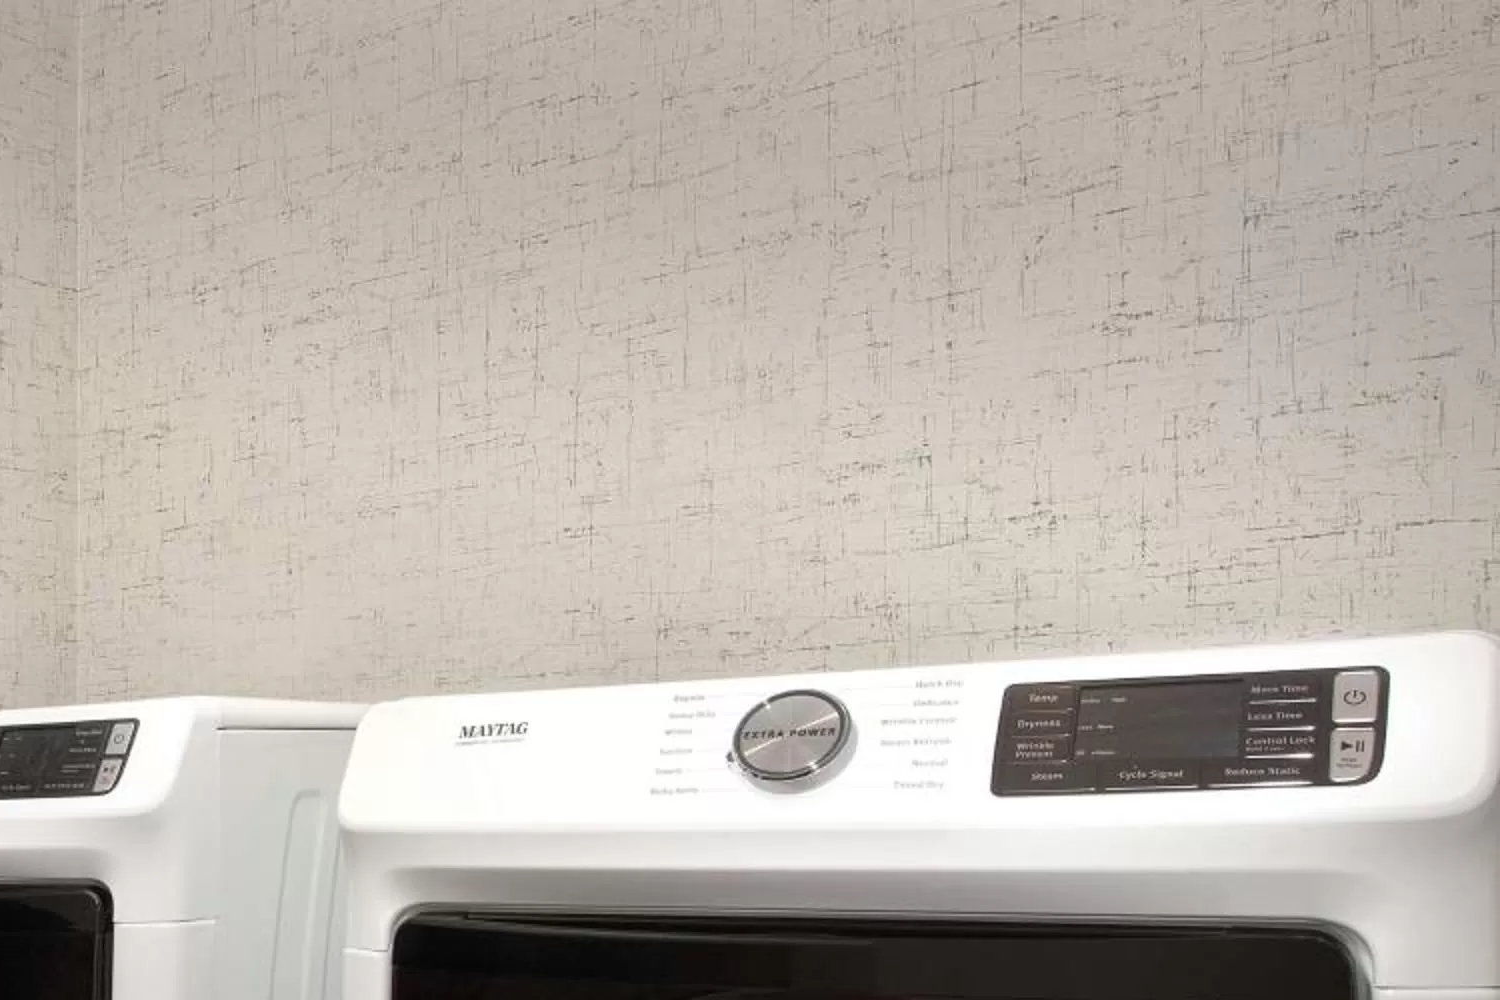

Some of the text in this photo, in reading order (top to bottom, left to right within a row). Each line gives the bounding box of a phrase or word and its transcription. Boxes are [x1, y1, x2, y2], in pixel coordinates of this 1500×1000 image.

[1250, 684, 1309, 694] More Time
[1028, 693, 1060, 704] Temp
[1247, 711, 1303, 721] Less Time
[459, 721, 529, 739] MAYTAG
[1016, 719, 1061, 731] Dryness
[741, 726, 836, 740] EXTRA POWER
[1245, 735, 1316, 746] Control Lock
[1031, 772, 1064, 781] Steam
[1118, 769, 1185, 782] Cycle Signal
[1224, 766, 1301, 777] Reduce Static
